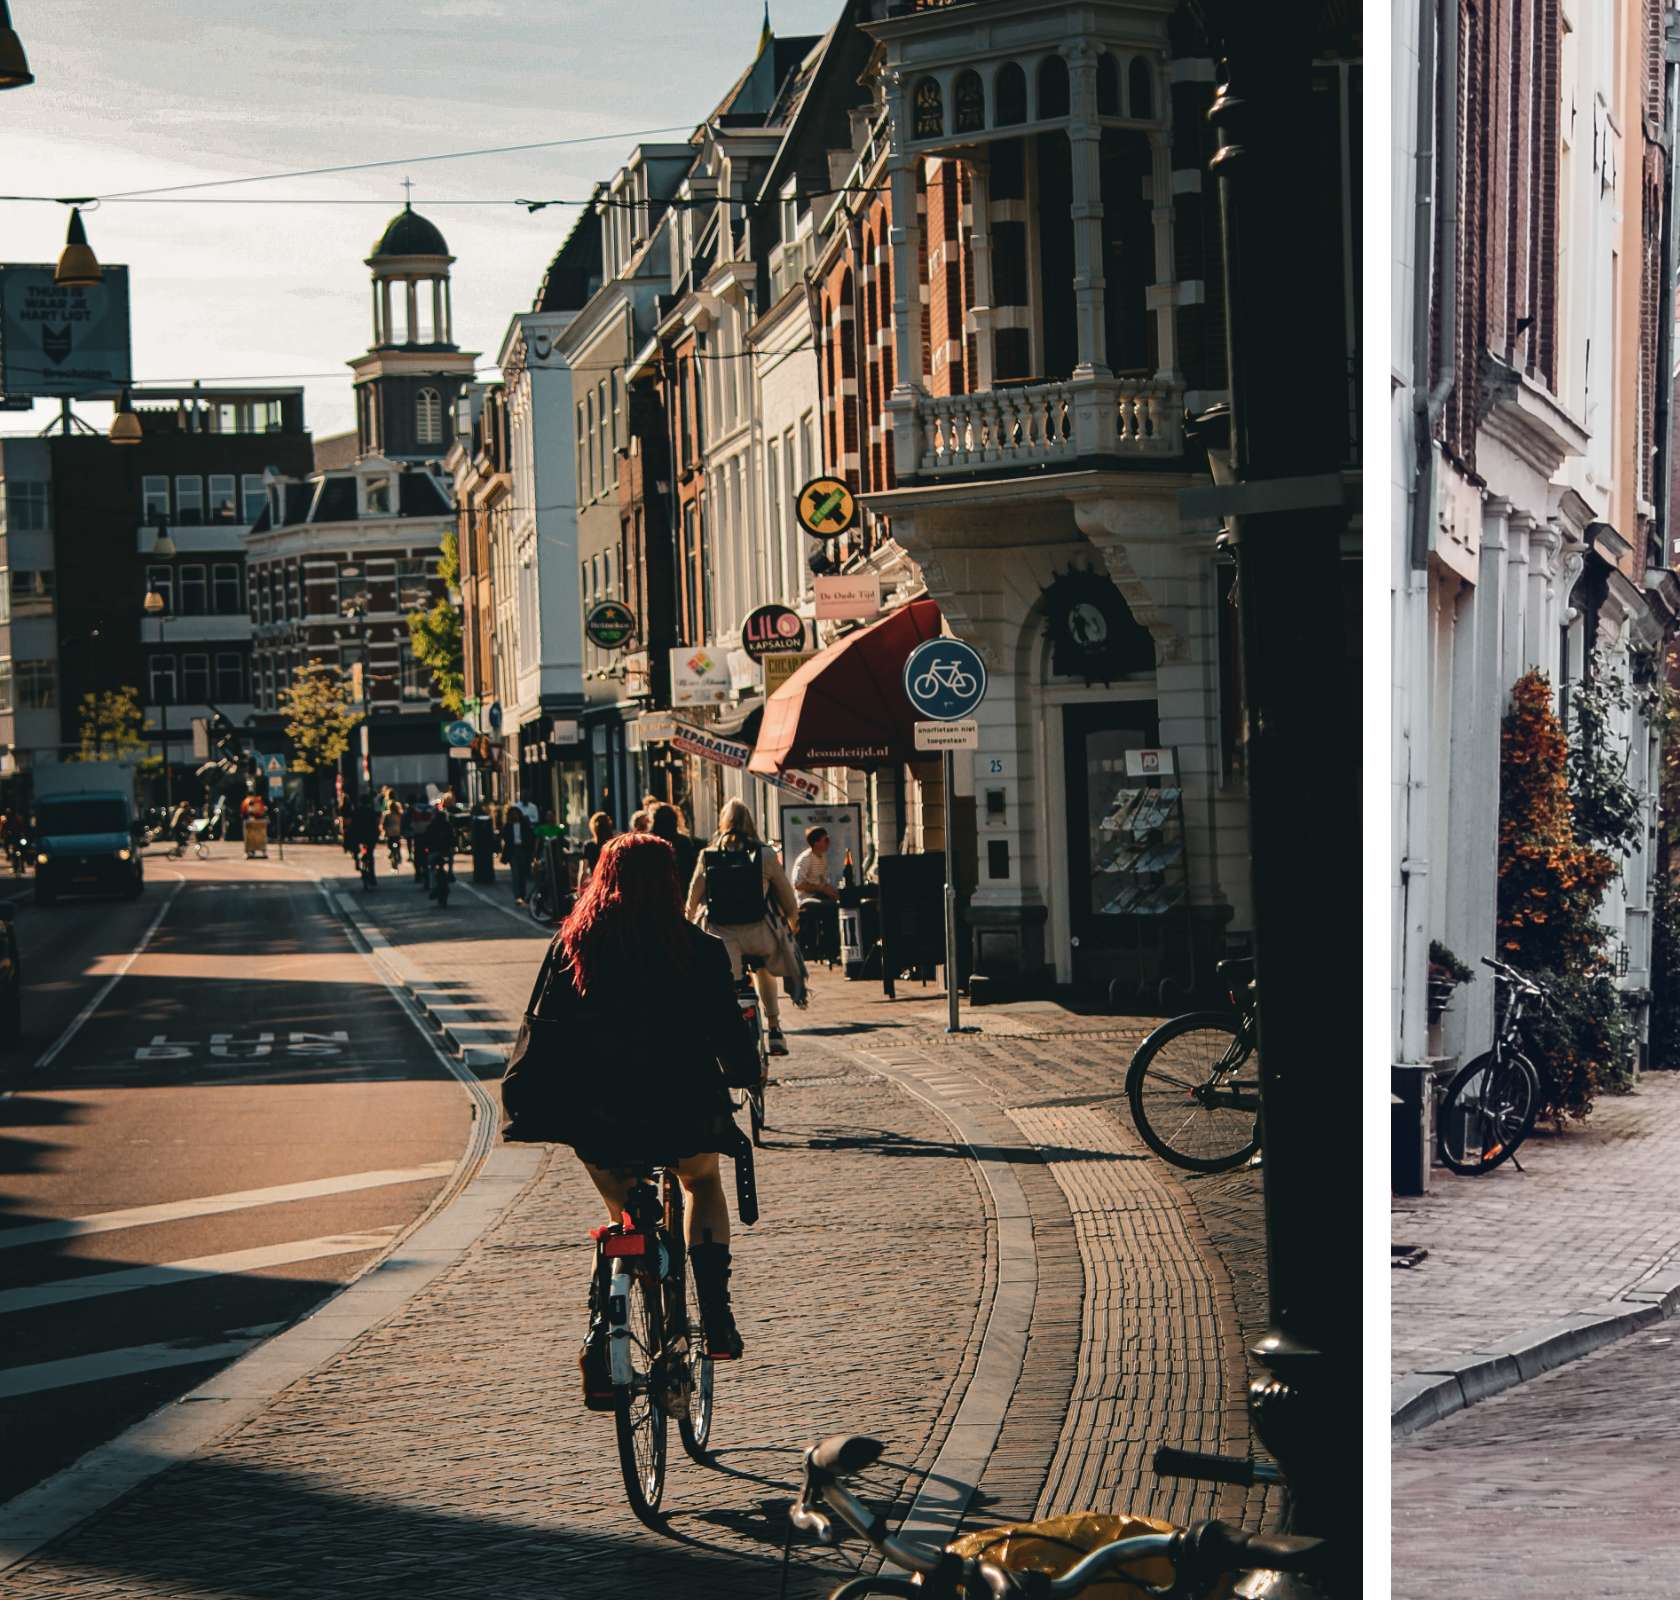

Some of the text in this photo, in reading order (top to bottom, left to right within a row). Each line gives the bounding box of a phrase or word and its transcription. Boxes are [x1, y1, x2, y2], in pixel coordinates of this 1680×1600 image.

[20, 311, 57, 321] HART
[819, 592, 831, 601] De
[834, 591, 855, 600] Oude
[747, 613, 801, 641] LILO
[750, 638, 801, 651] KAPSALON
[674, 727, 748, 759] REPARATIES
[928, 738, 967, 746] toegestaan
[807, 746, 889, 759] deoudetijd.nl
[991, 760, 1002, 773] 25
